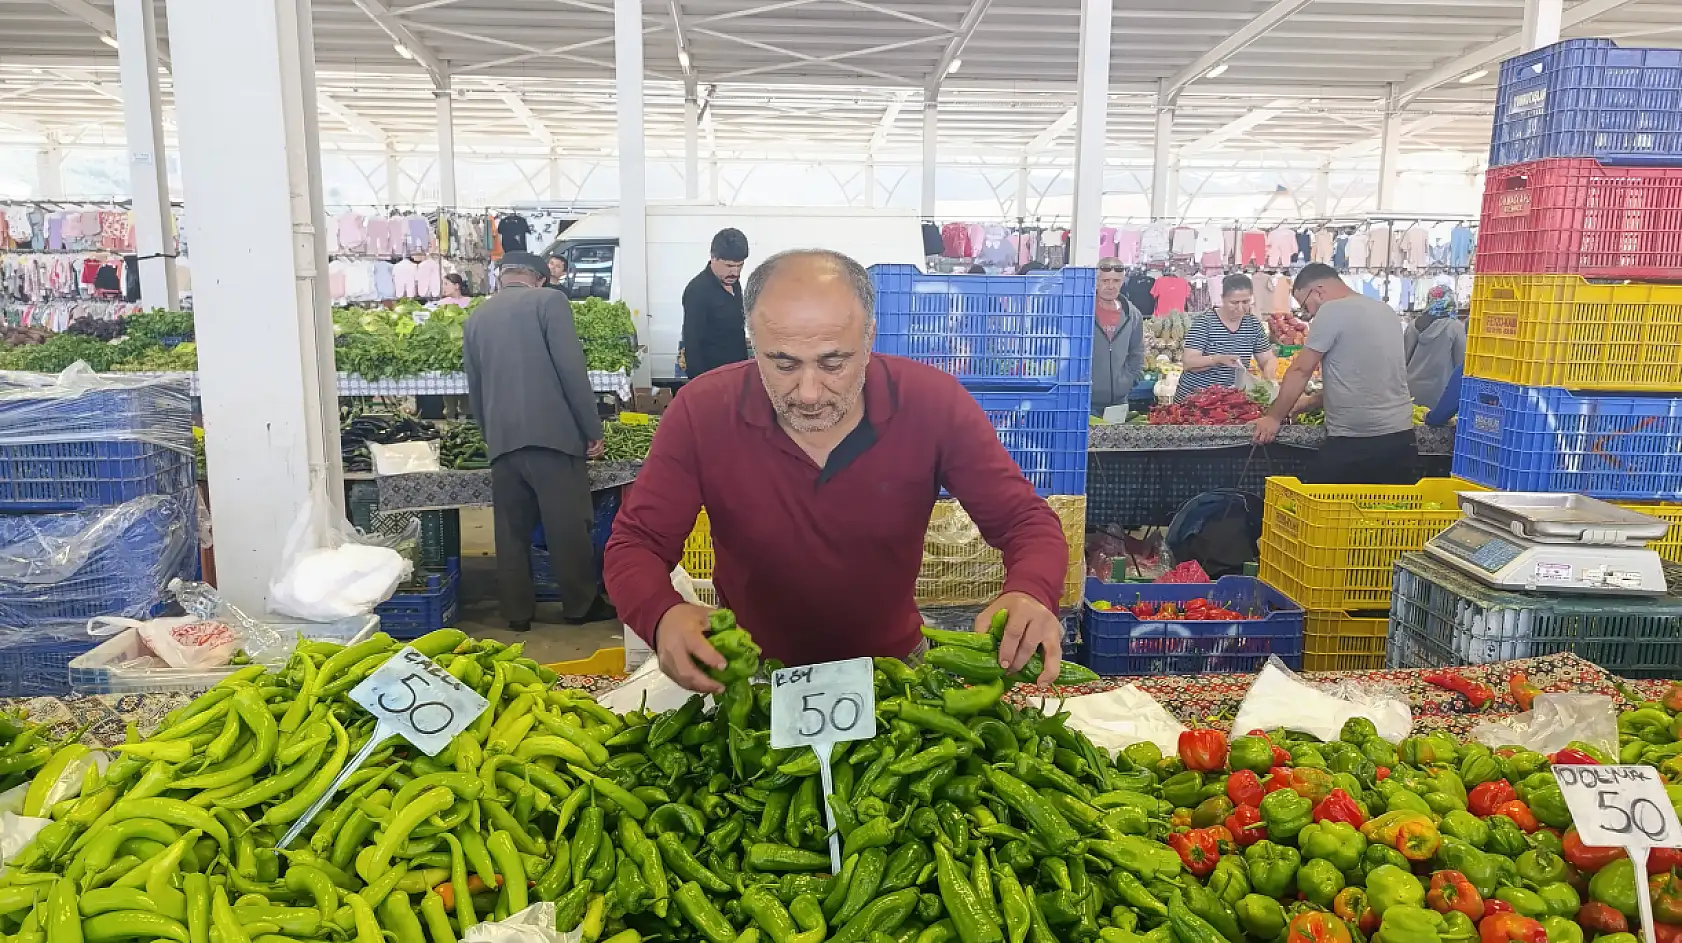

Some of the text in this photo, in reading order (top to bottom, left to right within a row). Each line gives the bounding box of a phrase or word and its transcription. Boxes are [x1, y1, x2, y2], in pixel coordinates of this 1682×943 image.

[377, 673, 455, 735] 50
[798, 692, 863, 738] 50
[1598, 791, 1667, 841] 50
